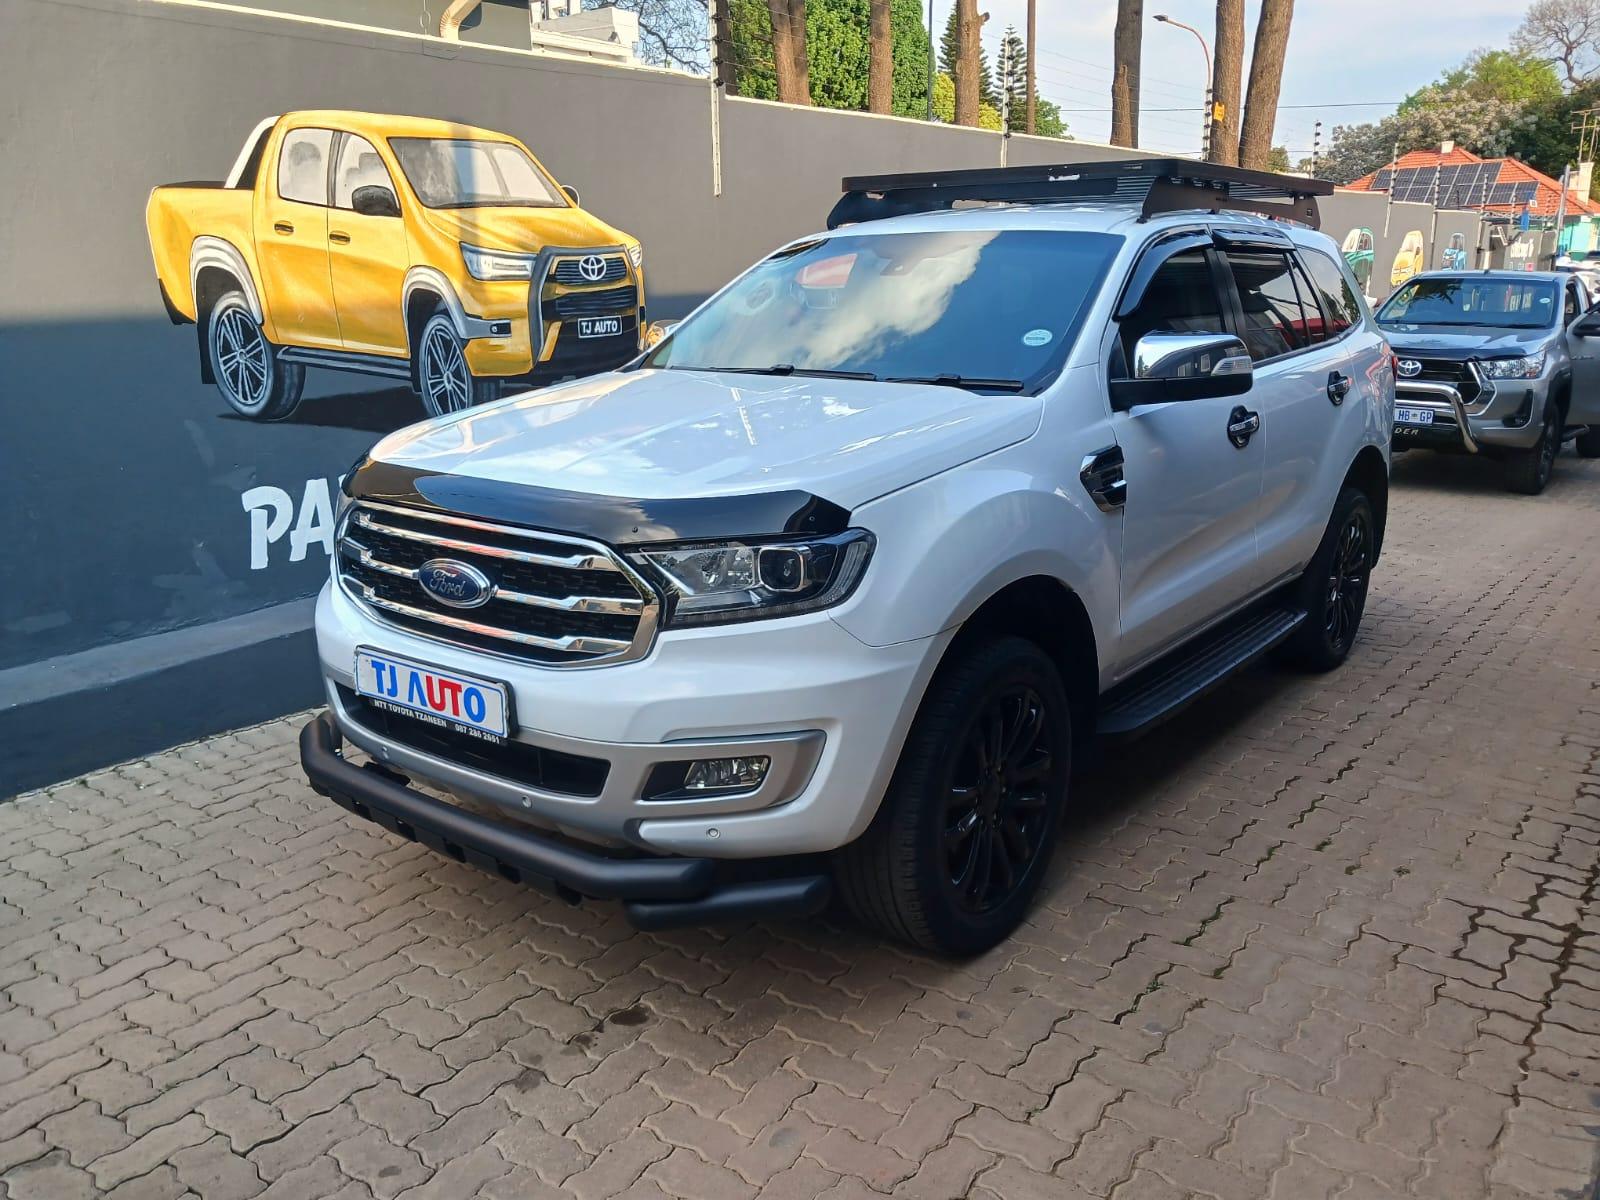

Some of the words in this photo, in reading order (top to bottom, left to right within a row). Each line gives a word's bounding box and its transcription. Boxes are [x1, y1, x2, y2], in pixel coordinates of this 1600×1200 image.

[581, 321, 592, 334] TJ
[594, 320, 618, 333] AUTO
[1398, 410, 1410, 420] HB
[1420, 411, 1432, 422] GP
[241, 474, 347, 570] PA
[429, 569, 466, 597] Ford
[371, 659, 399, 698] TJ
[408, 671, 487, 723] AUTO
[389, 704, 414, 718] TOYOTA
[415, 711, 447, 728] TZANEEN
